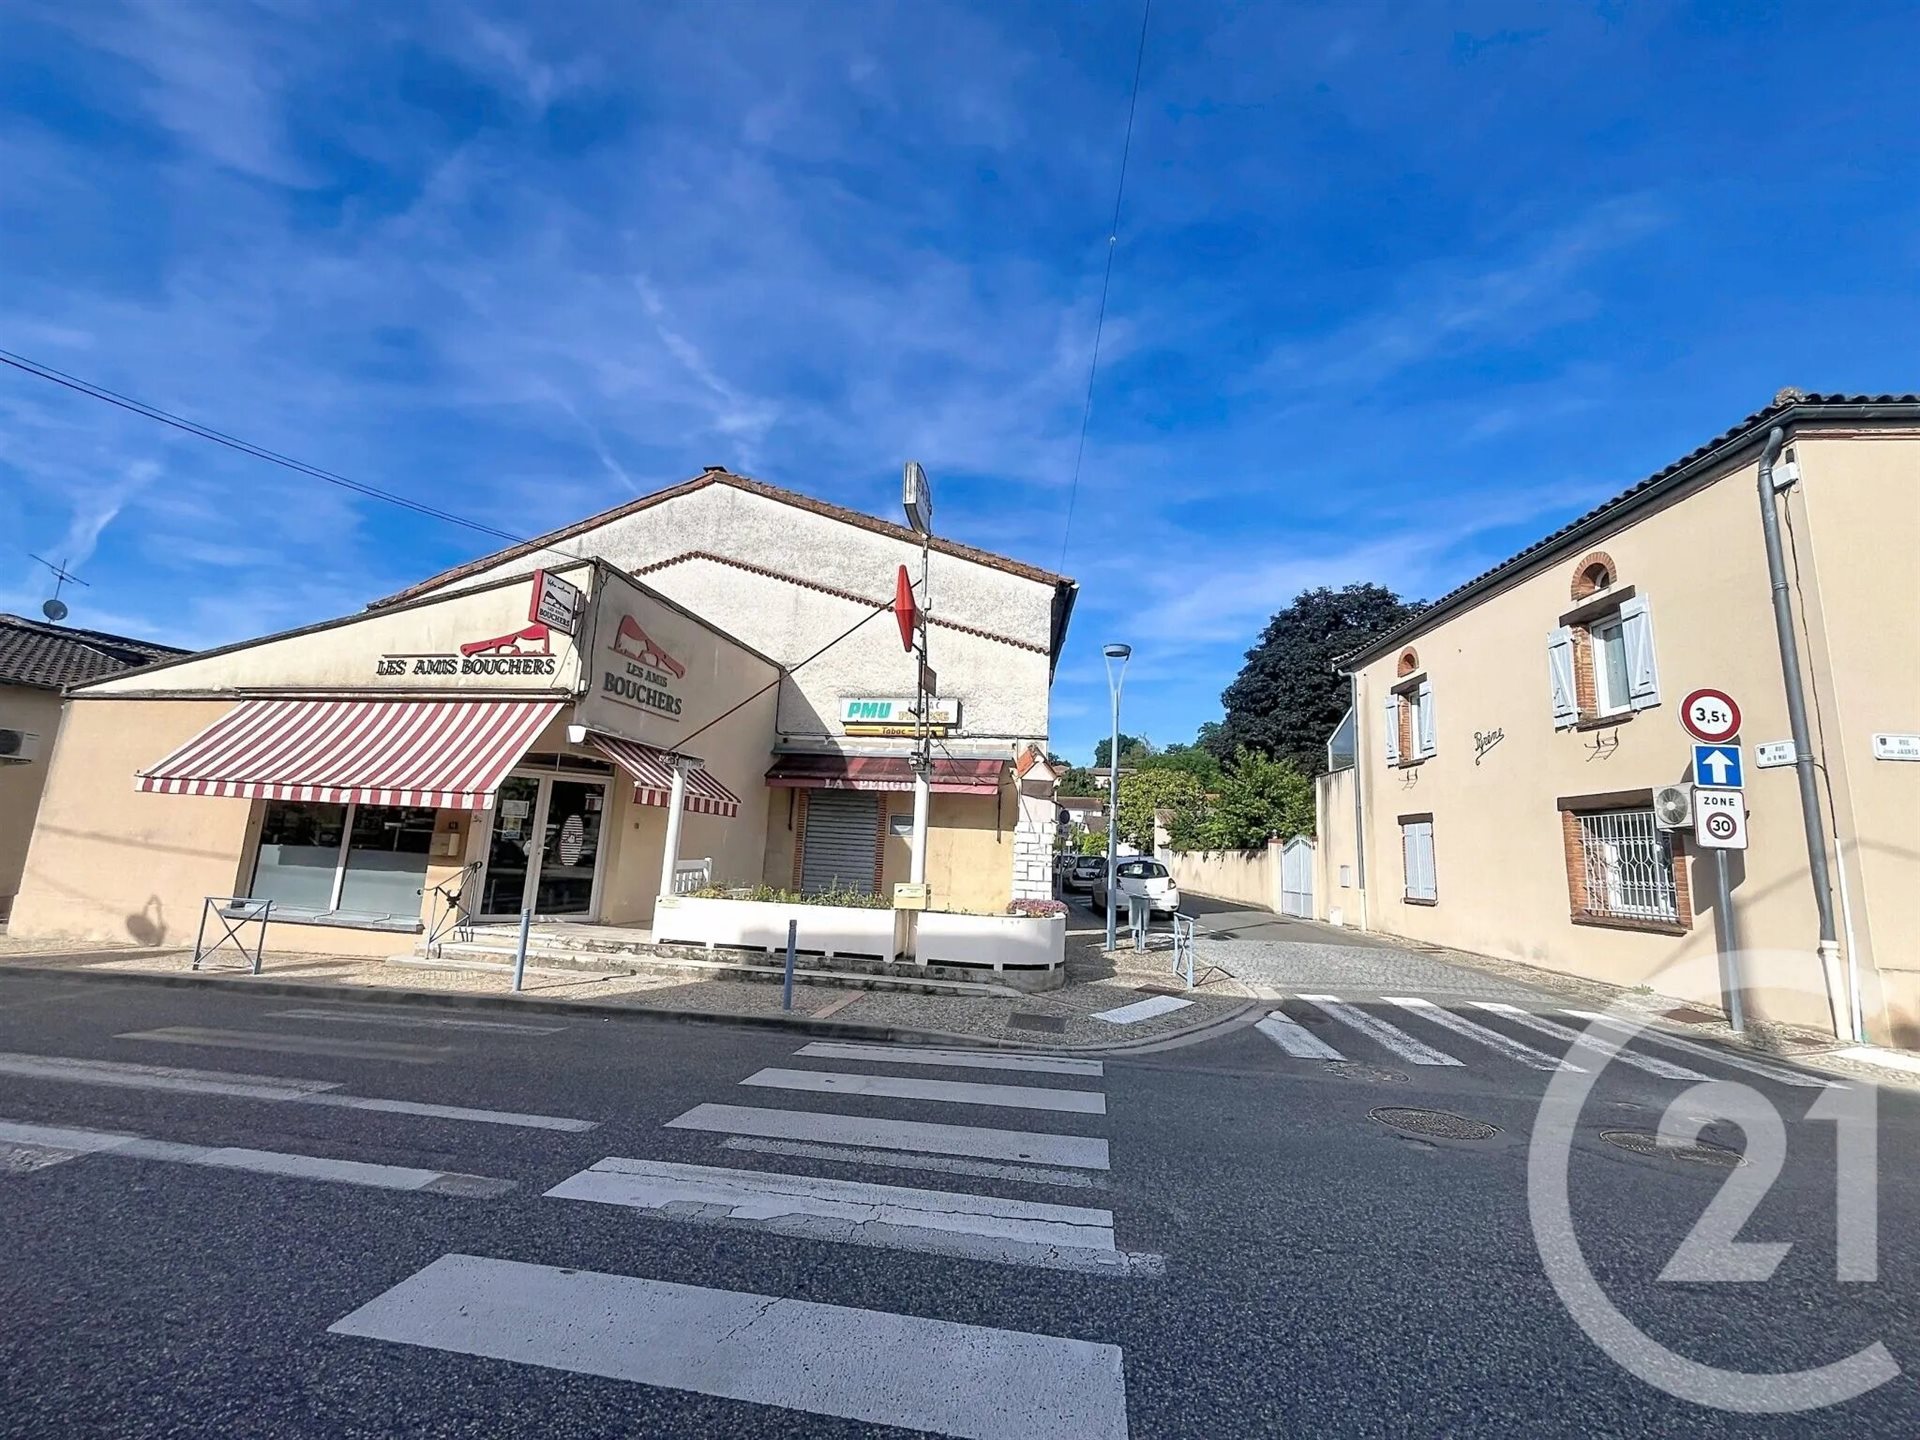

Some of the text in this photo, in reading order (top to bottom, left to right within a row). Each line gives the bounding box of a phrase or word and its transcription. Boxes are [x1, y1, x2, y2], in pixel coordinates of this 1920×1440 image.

[539, 608, 570, 627] BOUCHERS
[376, 658, 556, 676] LES AMIS BOUCHERS
[626, 662, 668, 688] LES AMIS
[603, 672, 683, 715] BOUCHERS
[847, 702, 892, 719] PMU
[882, 727, 906, 735] Tabac
[825, 779, 844, 788] LA
[1703, 796, 1735, 807] ZONE
[1712, 820, 1731, 832] 30
